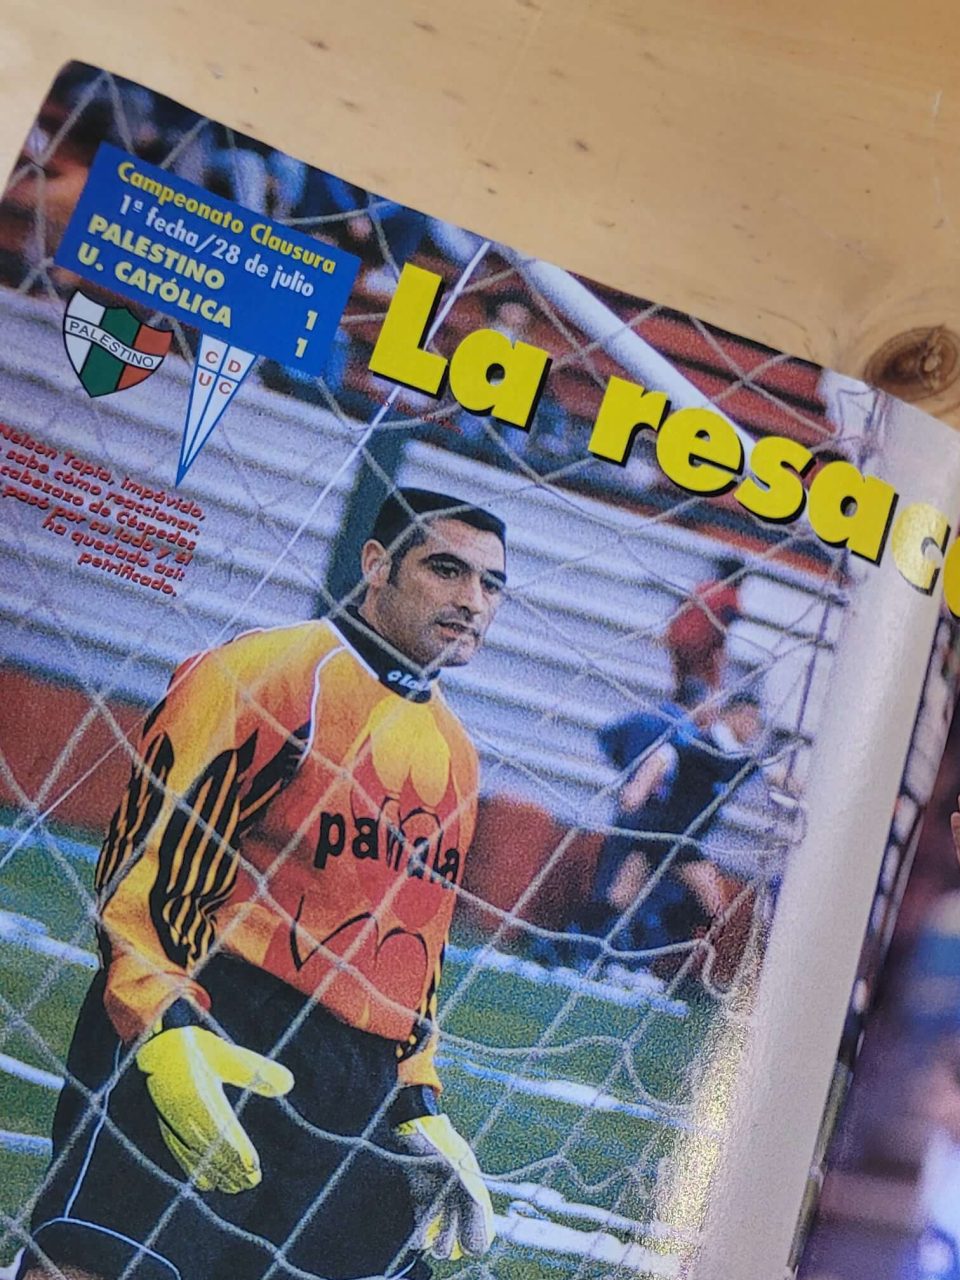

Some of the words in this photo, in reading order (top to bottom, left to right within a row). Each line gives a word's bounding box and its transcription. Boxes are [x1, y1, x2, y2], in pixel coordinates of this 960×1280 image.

[117, 162, 243, 234] Campeonato
[250, 223, 336, 275] Clausura
[119, 194, 144, 215] 1ª
[145, 202, 241, 265] fecha/28
[244, 253, 269, 278] de
[271, 265, 314, 297] julio
[77, 242, 104, 272] U.
[114, 260, 232, 328] CATÓLICA
[295, 337, 308, 358] 1
[88, 214, 225, 290] PALESTINO
[305, 310, 318, 331] 1
[69, 321, 154, 368] PALESTINO
[368, 262, 552, 431] La
[1, 465, 83, 505] cabezazo
[89, 497, 110, 516] de
[116, 510, 197, 550] Céspedes
[2, 484, 50, 509] pasó
[52, 504, 84, 524] por
[89, 519, 109, 534] su
[114, 525, 153, 551] lado
[6, 449, 48, 473] sabe
[54, 469, 100, 494] cómo
[107, 490, 199, 535] reaccionar.
[62, 451, 114, 487] Tapia,
[121, 476, 203, 524] impávido,
[44, 515, 65, 534] ha
[70, 530, 148, 568] quedado
[79, 551, 175, 598] petrificado.
